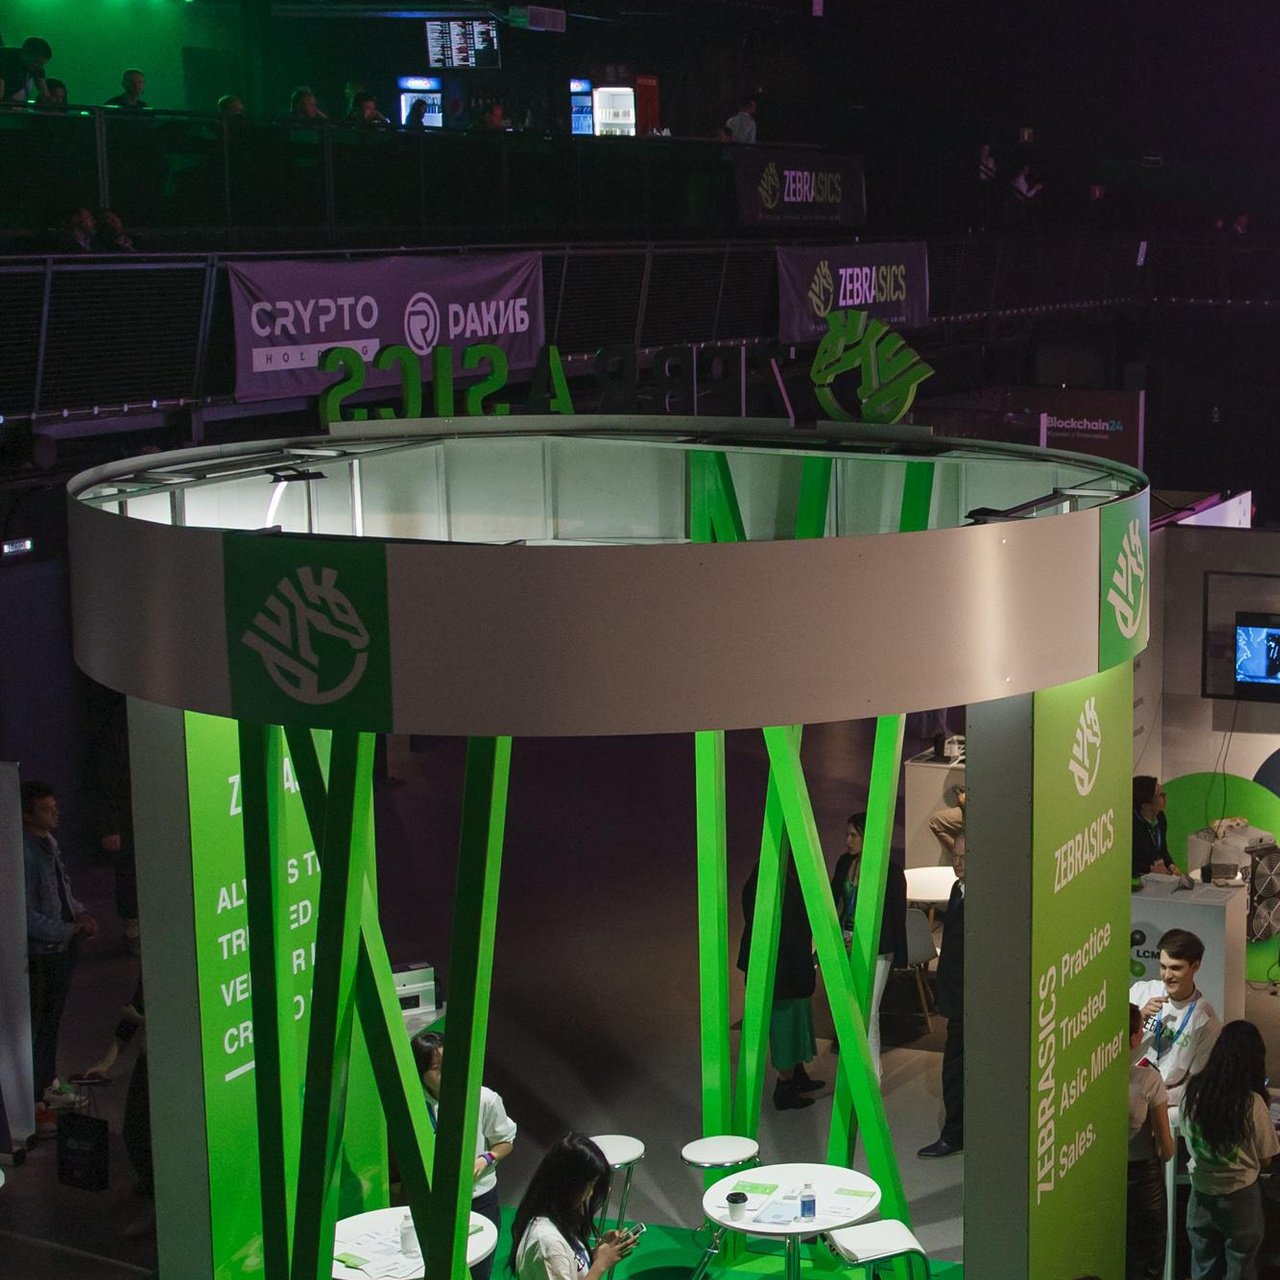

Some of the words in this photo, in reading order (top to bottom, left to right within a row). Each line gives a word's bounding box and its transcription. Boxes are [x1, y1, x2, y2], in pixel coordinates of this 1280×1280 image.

[783, 170, 842, 203] ZEBRASICS
[839, 264, 906, 307] ZEBRASICS
[251, 294, 379, 337] CRYPTO
[448, 297, 530, 340] РАКИБ
[265, 346, 369, 363] HOLG
[1054, 808, 1114, 894] ZEBRASICS
[1061, 923, 1111, 988] Practice
[1136, 949, 1160, 960] LCM
[1060, 980, 1107, 1052] Trusted
[1037, 965, 1056, 1206] ZEBRASICS
[1060, 1068, 1087, 1116] Asic
[1091, 1029, 1124, 1083] Miner
[1059, 1122, 1096, 1179] Sales.
